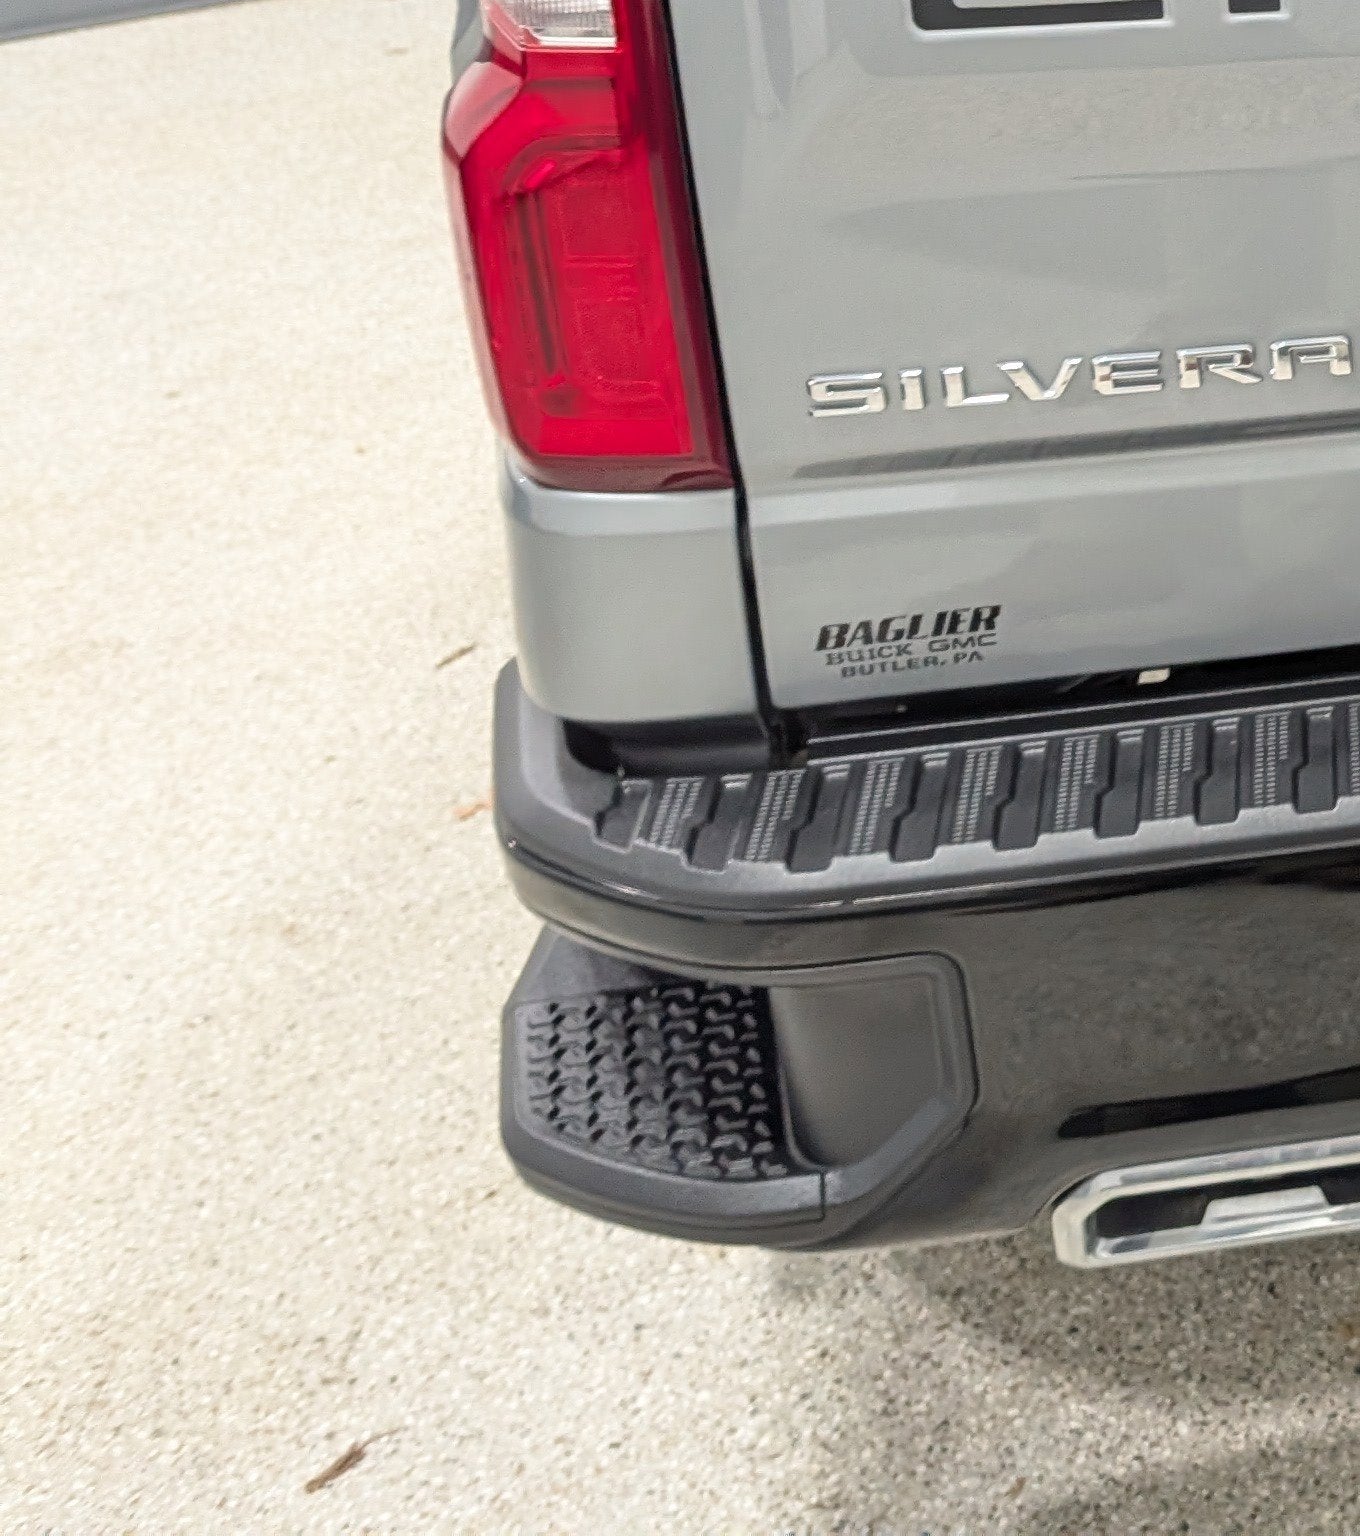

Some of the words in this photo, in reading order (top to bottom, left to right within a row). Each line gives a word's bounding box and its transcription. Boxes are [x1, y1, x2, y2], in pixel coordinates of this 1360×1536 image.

[815, 604, 1001, 651] BAGLIER
[825, 643, 912, 666] BUICK
[928, 633, 997, 652] GMC
[841, 655, 946, 678] BUTLER,
[953, 651, 984, 664] PA
